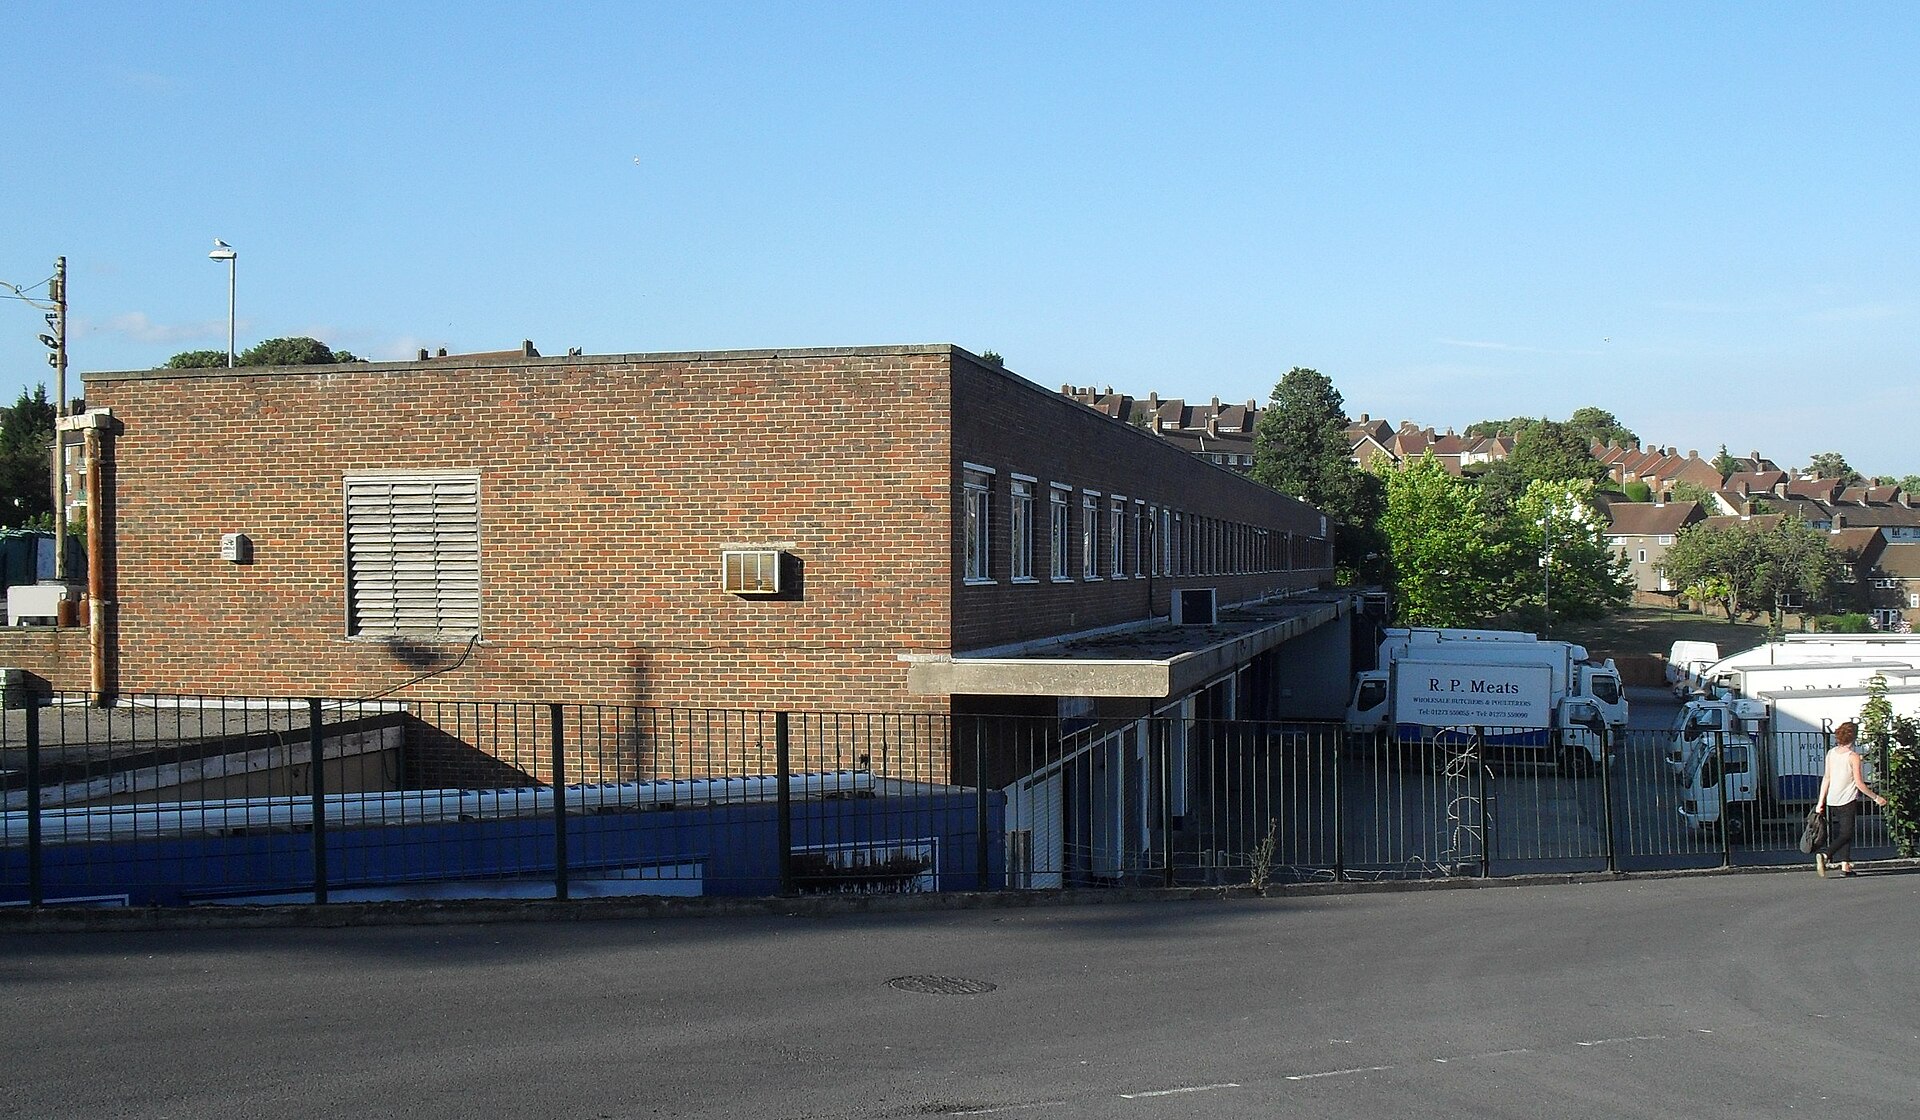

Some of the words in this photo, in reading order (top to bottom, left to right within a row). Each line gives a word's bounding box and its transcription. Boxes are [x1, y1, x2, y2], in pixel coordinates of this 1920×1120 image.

[1429, 678, 1444, 692] R.
[1450, 679, 1465, 693] P.
[1470, 680, 1519, 694] Meats
[1413, 696, 1450, 704] WHOLESALE
[1451, 698, 1484, 706] BUTCHERS
